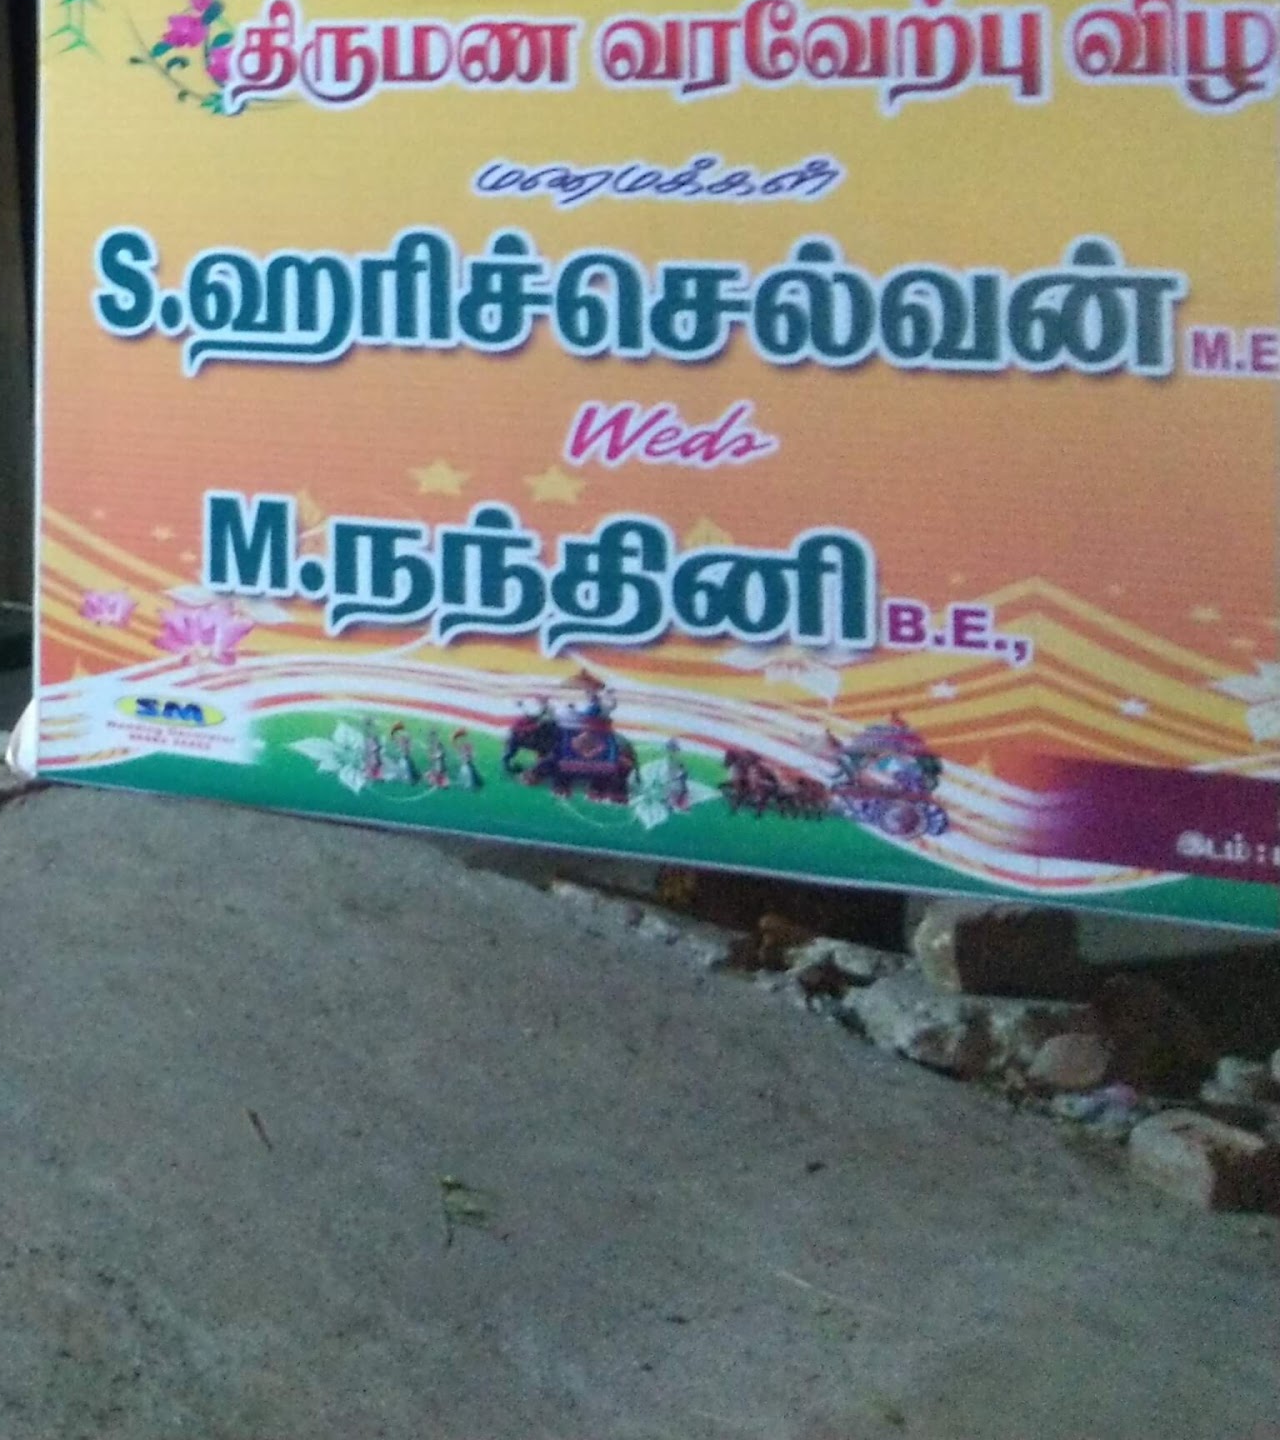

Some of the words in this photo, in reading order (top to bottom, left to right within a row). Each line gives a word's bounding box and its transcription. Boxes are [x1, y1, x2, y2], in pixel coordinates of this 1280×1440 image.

[474, 156, 840, 205] மணமக்கள்
[96, 231, 1180, 374] S.ஹரிச்செல்வன்
[569, 405, 772, 463] Weds
[206, 494, 874, 652] M.நந்தினி
[887, 602, 1033, 666] B.E.,
[135, 698, 205, 726] SM
